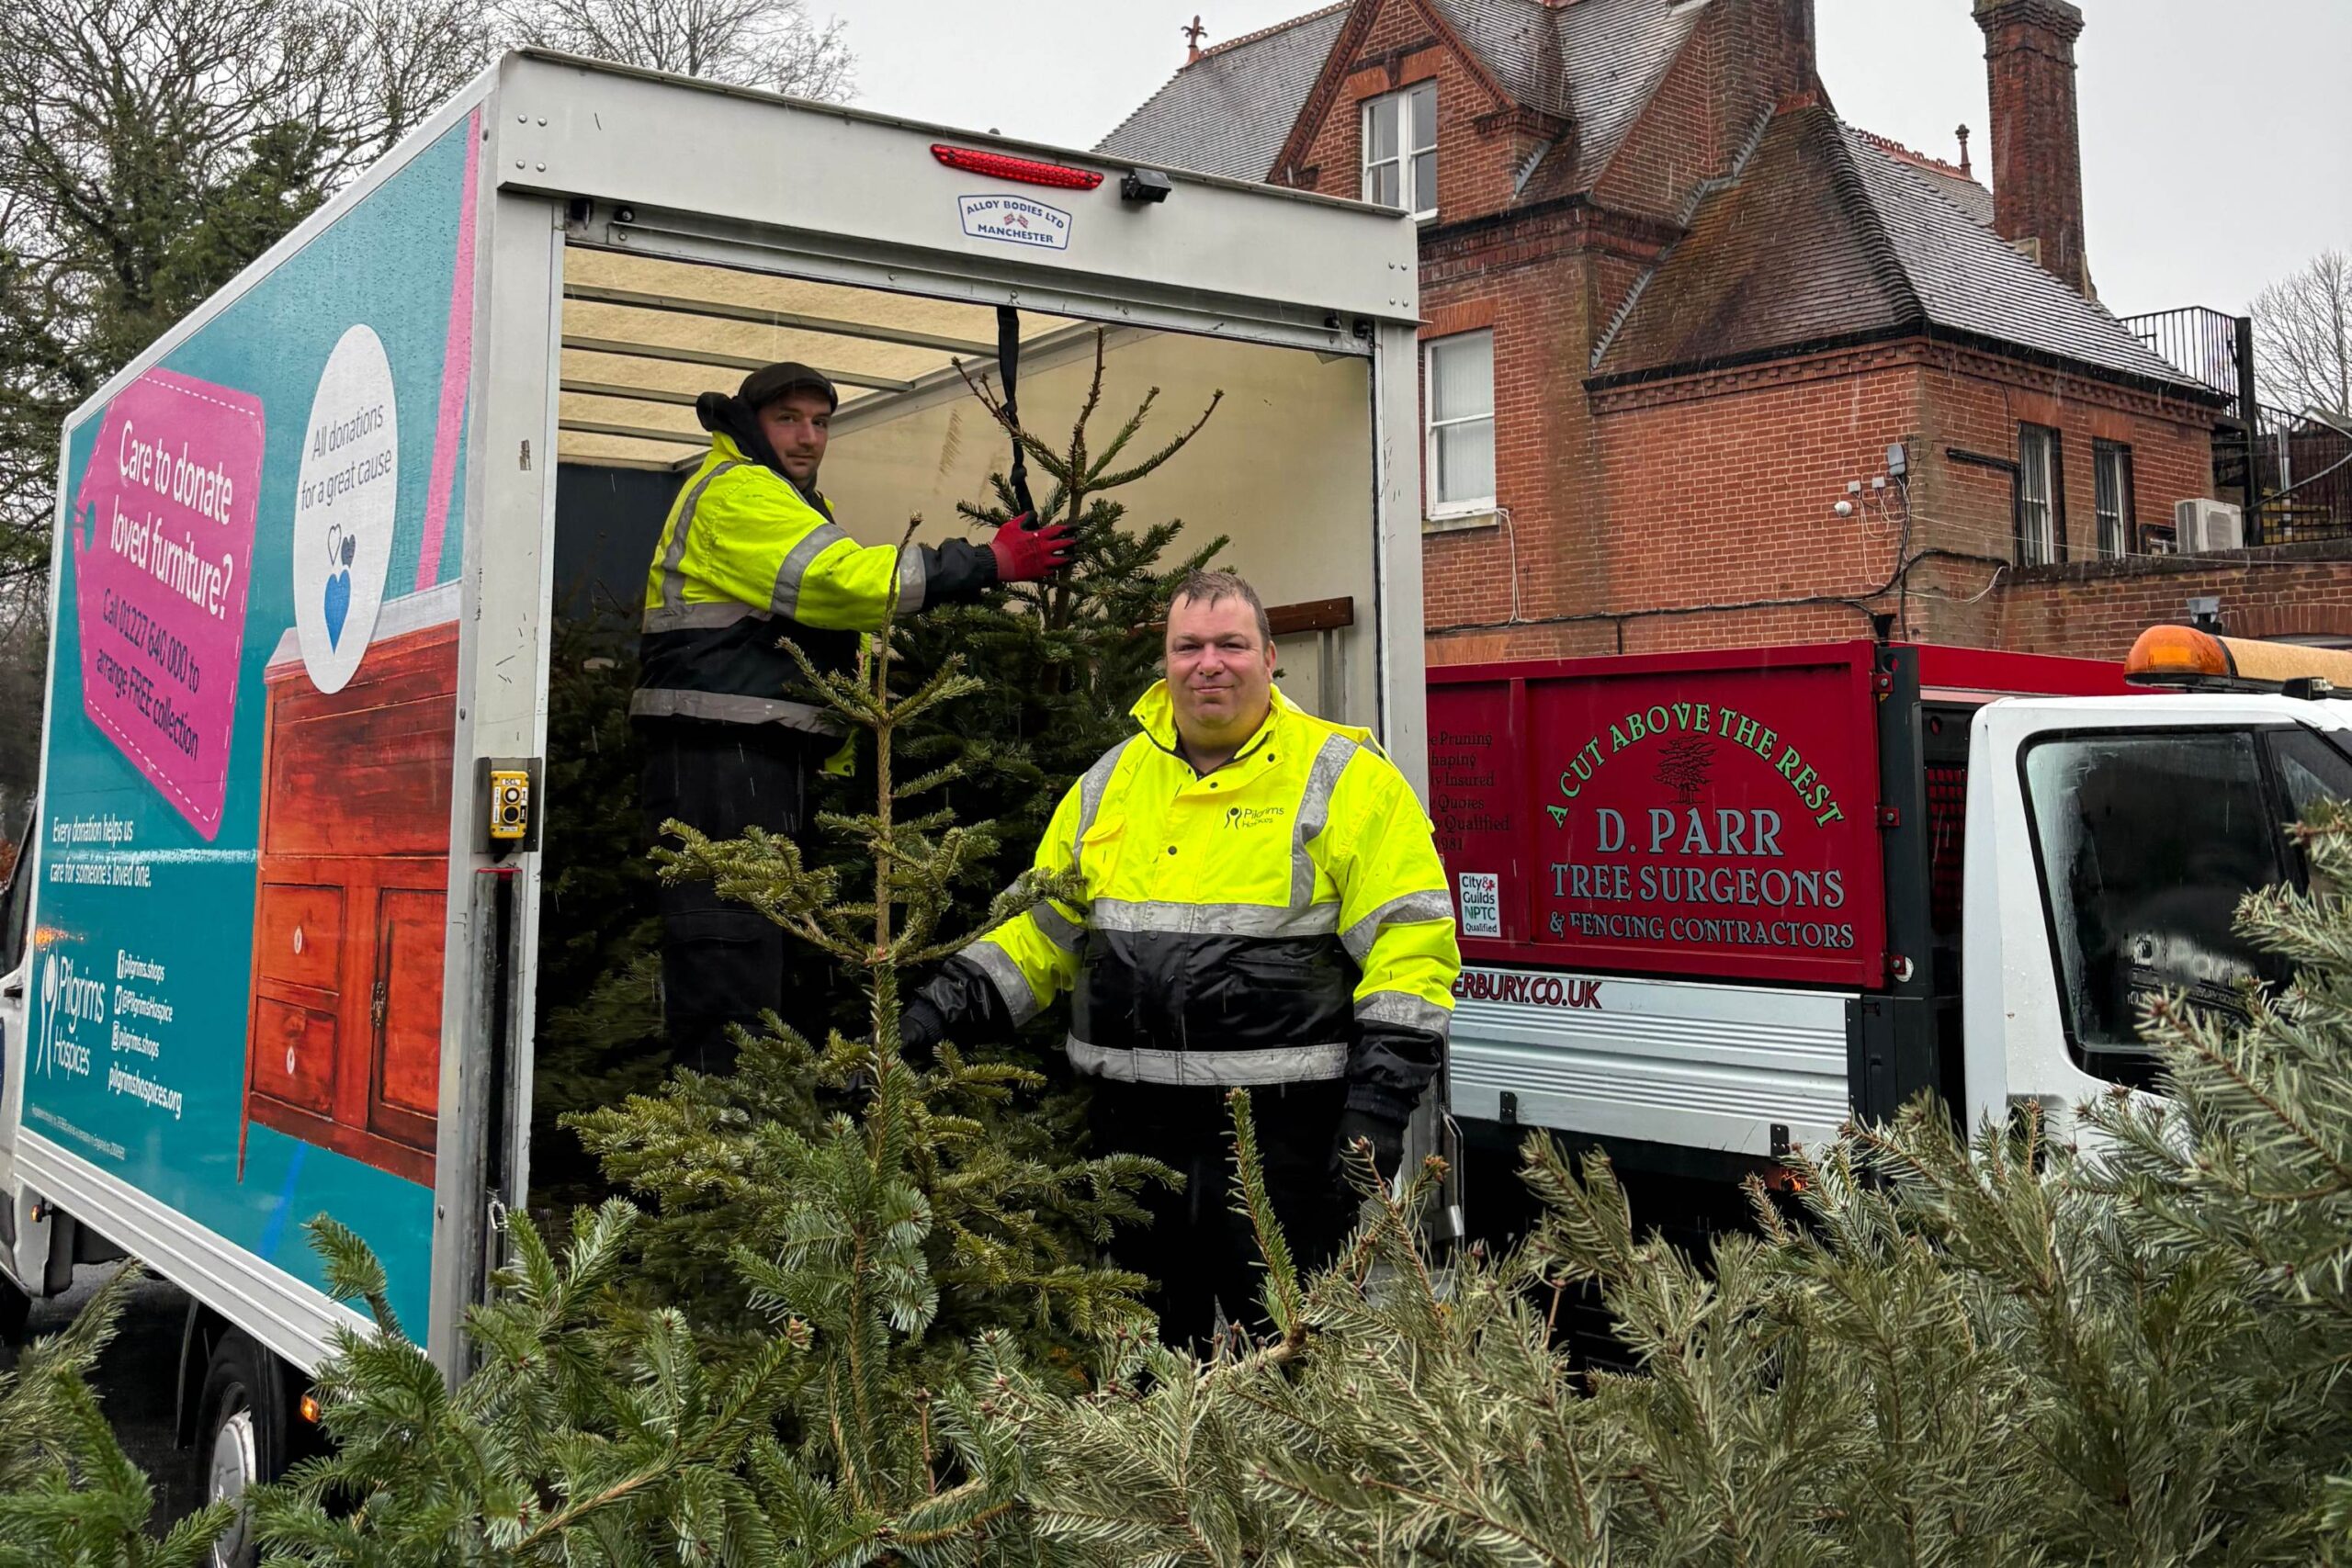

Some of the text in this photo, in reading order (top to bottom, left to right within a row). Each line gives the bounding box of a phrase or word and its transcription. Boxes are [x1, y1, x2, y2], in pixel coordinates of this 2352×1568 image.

[967, 200, 1064, 229] ALLOY BODIES LTD
[978, 224, 1054, 243] MANCHESTER
[311, 404, 384, 461] All donations
[119, 419, 233, 525] Care to donate
[301, 449, 392, 511] for a great cause
[110, 493, 233, 620] loved furniture?
[103, 587, 200, 694] Call 01227 640 000 to
[96, 649, 199, 761] arrange FREE collection
[1545, 701, 1845, 829] A CUT ABOVE THE REST
[52, 813, 133, 848] Every donation helps us
[1595, 807, 1785, 856] D. PARR
[51, 856, 152, 888] care for someone's loved one.
[1463, 891, 1495, 905] Guilds
[1550, 862, 1845, 908] TREE SURGEONS
[1464, 906, 1497, 920] NPTC
[1465, 921, 1498, 933] Qualified
[1549, 910, 1855, 949] & FENCING CONTRACTORS
[58, 955, 106, 1033] Pilgrims
[53, 1025, 91, 1081] Hospices
[108, 1061, 183, 1120] pilgrimshospices.org
